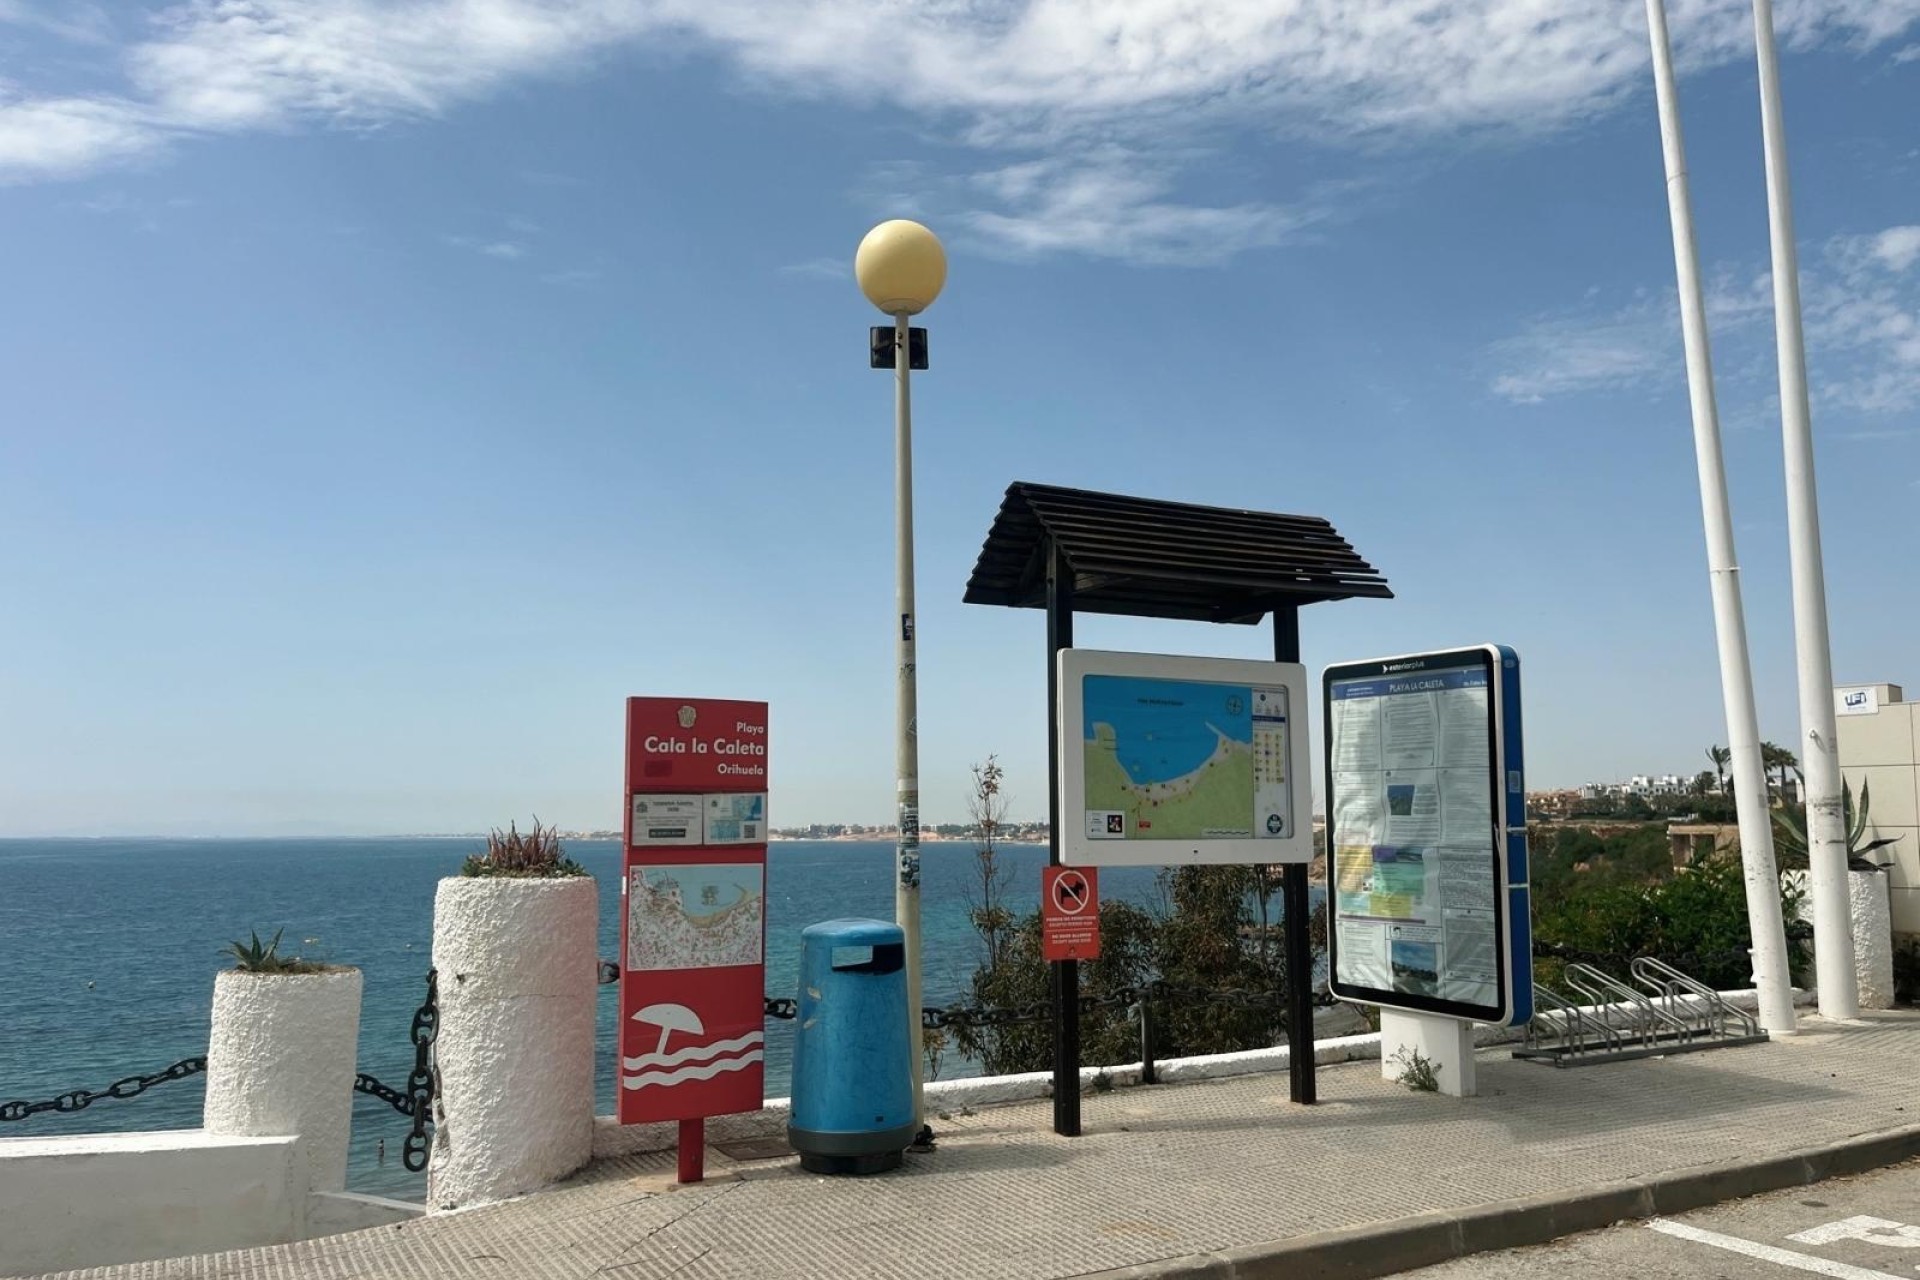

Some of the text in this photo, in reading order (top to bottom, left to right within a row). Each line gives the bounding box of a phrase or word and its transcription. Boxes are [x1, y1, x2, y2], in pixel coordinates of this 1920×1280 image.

[1419, 679, 1445, 689] CALETA
[736, 721, 764, 736] Playa
[644, 736, 764, 755] Cala la Caleta
[717, 763, 764, 775] Orihuela
